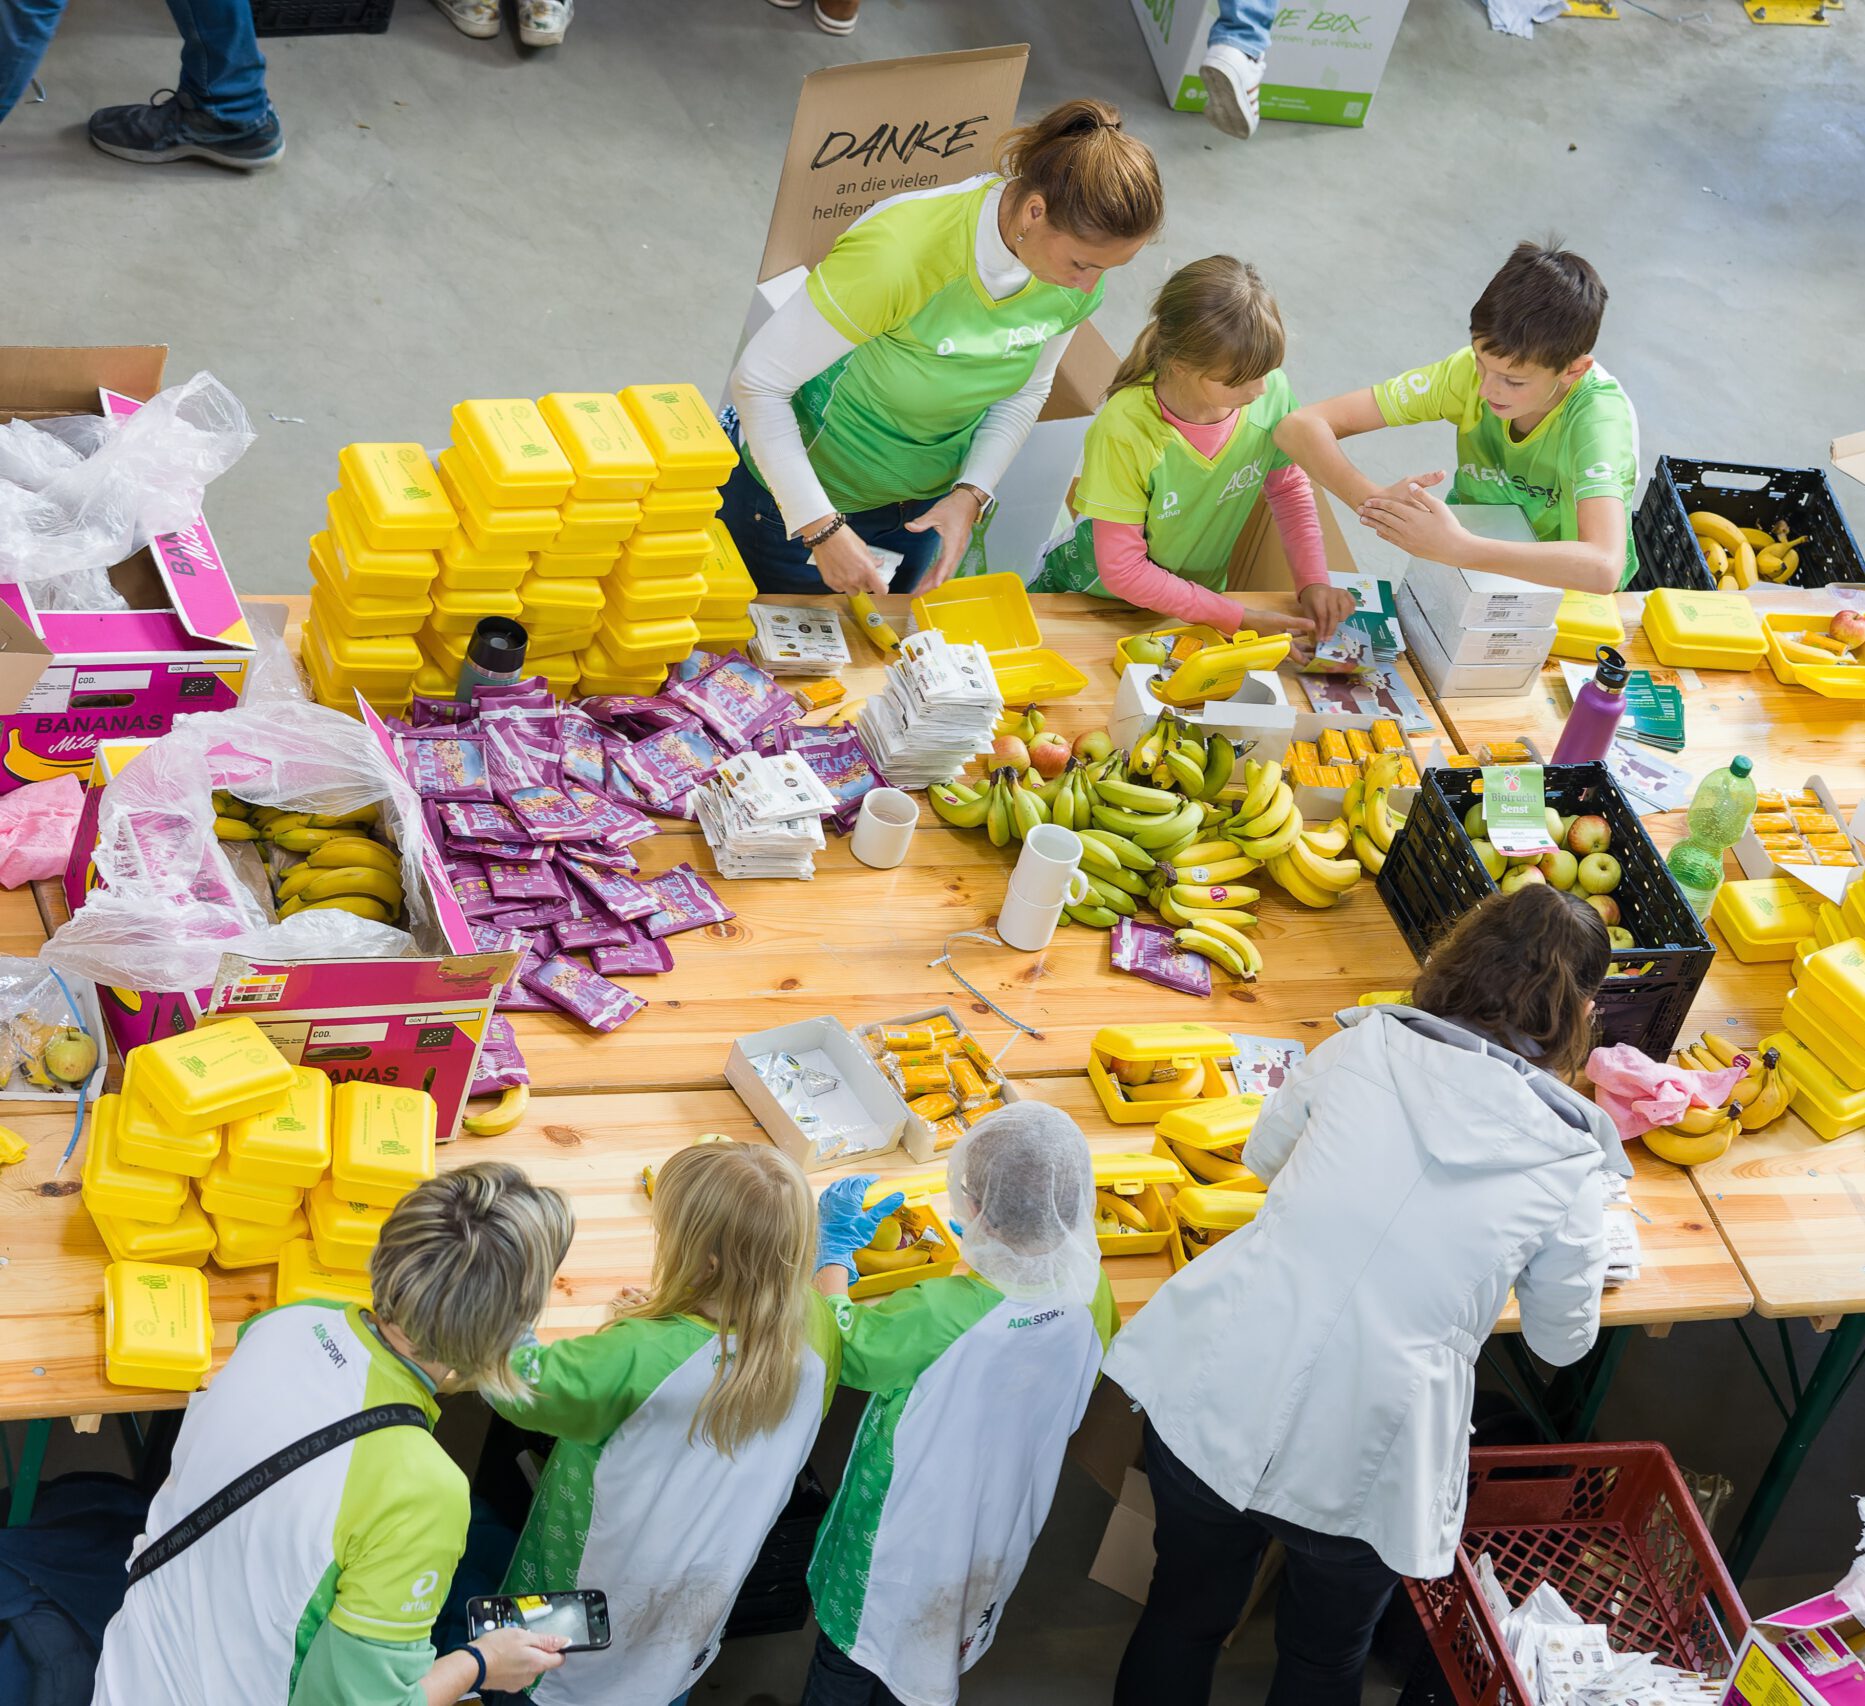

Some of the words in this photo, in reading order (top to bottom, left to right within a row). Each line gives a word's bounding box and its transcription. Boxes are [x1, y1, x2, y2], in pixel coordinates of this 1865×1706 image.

[1308, 11, 1371, 34] BOX
[811, 115, 989, 171] DANKE
[836, 182, 856, 195] an
[861, 177, 886, 192] die
[891, 172, 938, 190] vielen
[1004, 322, 1048, 353] AOK
[1219, 454, 1265, 499] AOK
[35, 714, 163, 733] BANANAS
[803, 751, 831, 760] Beeren
[1491, 792, 1537, 803] Biofrucht
[1500, 804, 1529, 814] Senst
[313, 1030, 331, 1038] COD.
[336, 1408, 401, 1441] TOMMY
[279, 1431, 329, 1470] JEANS
[225, 1469, 272, 1505] TOMMY
